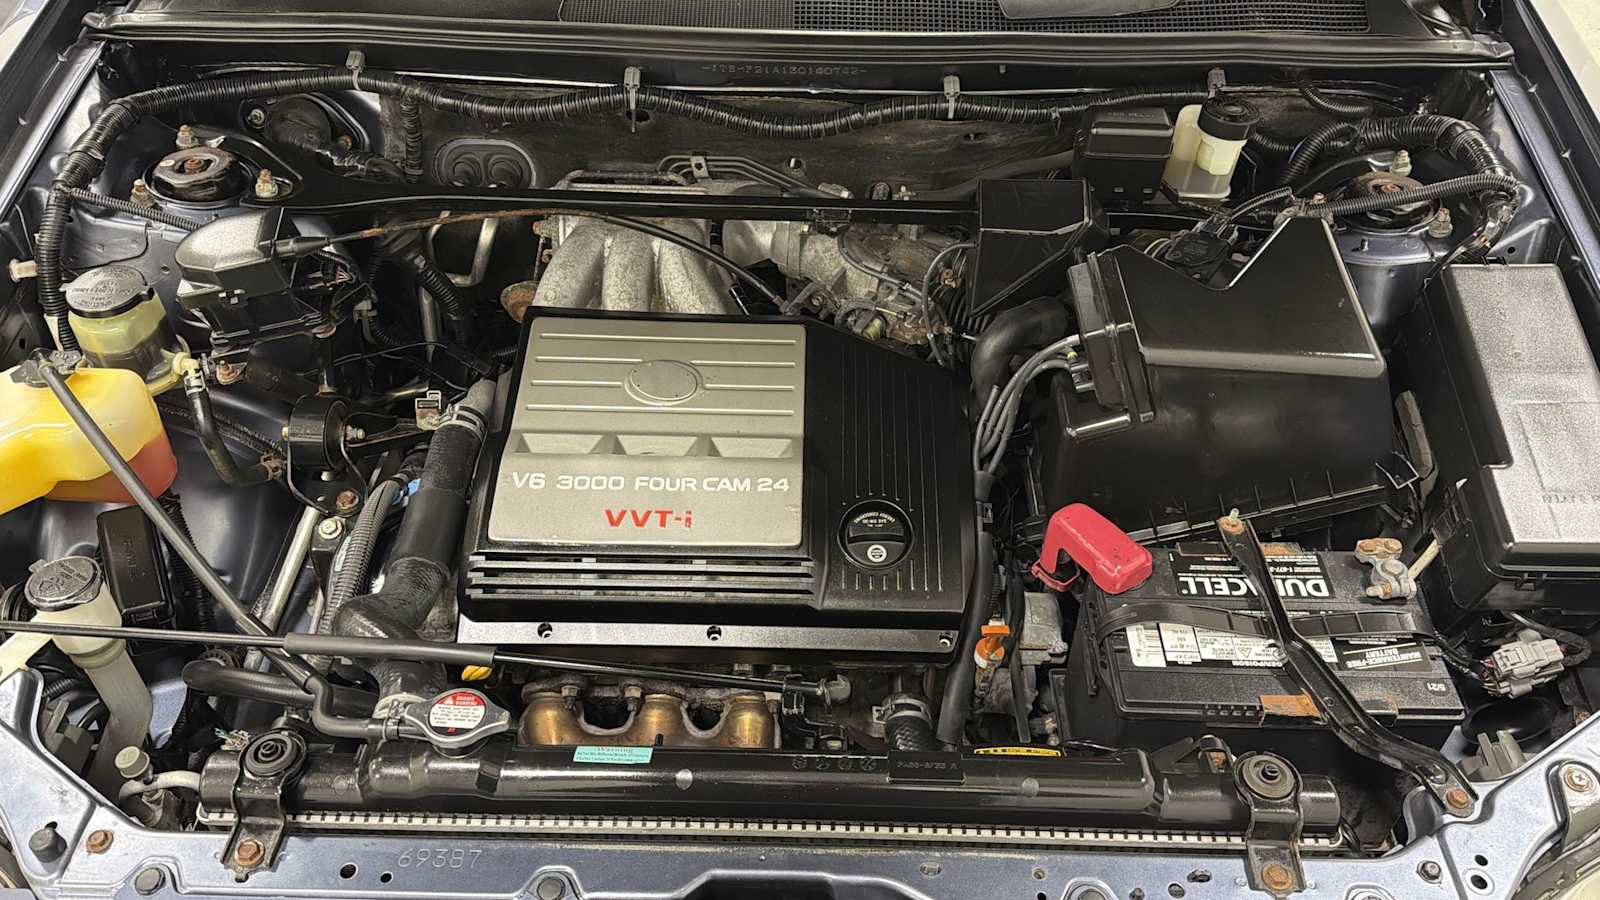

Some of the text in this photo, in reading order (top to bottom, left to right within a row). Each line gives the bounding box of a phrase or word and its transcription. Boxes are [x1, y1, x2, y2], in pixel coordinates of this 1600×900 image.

[512, 472, 790, 493] V6 3000 FOUR CAM 24
[604, 509, 692, 528] VVT-i
[1178, 577, 1330, 597] DUCELL
[1345, 651, 1422, 668] MAINTENANCE-FREE
[1364, 647, 1398, 659] BATTERY
[1426, 682, 1447, 692] 5/21
[398, 847, 483, 869] 69387
